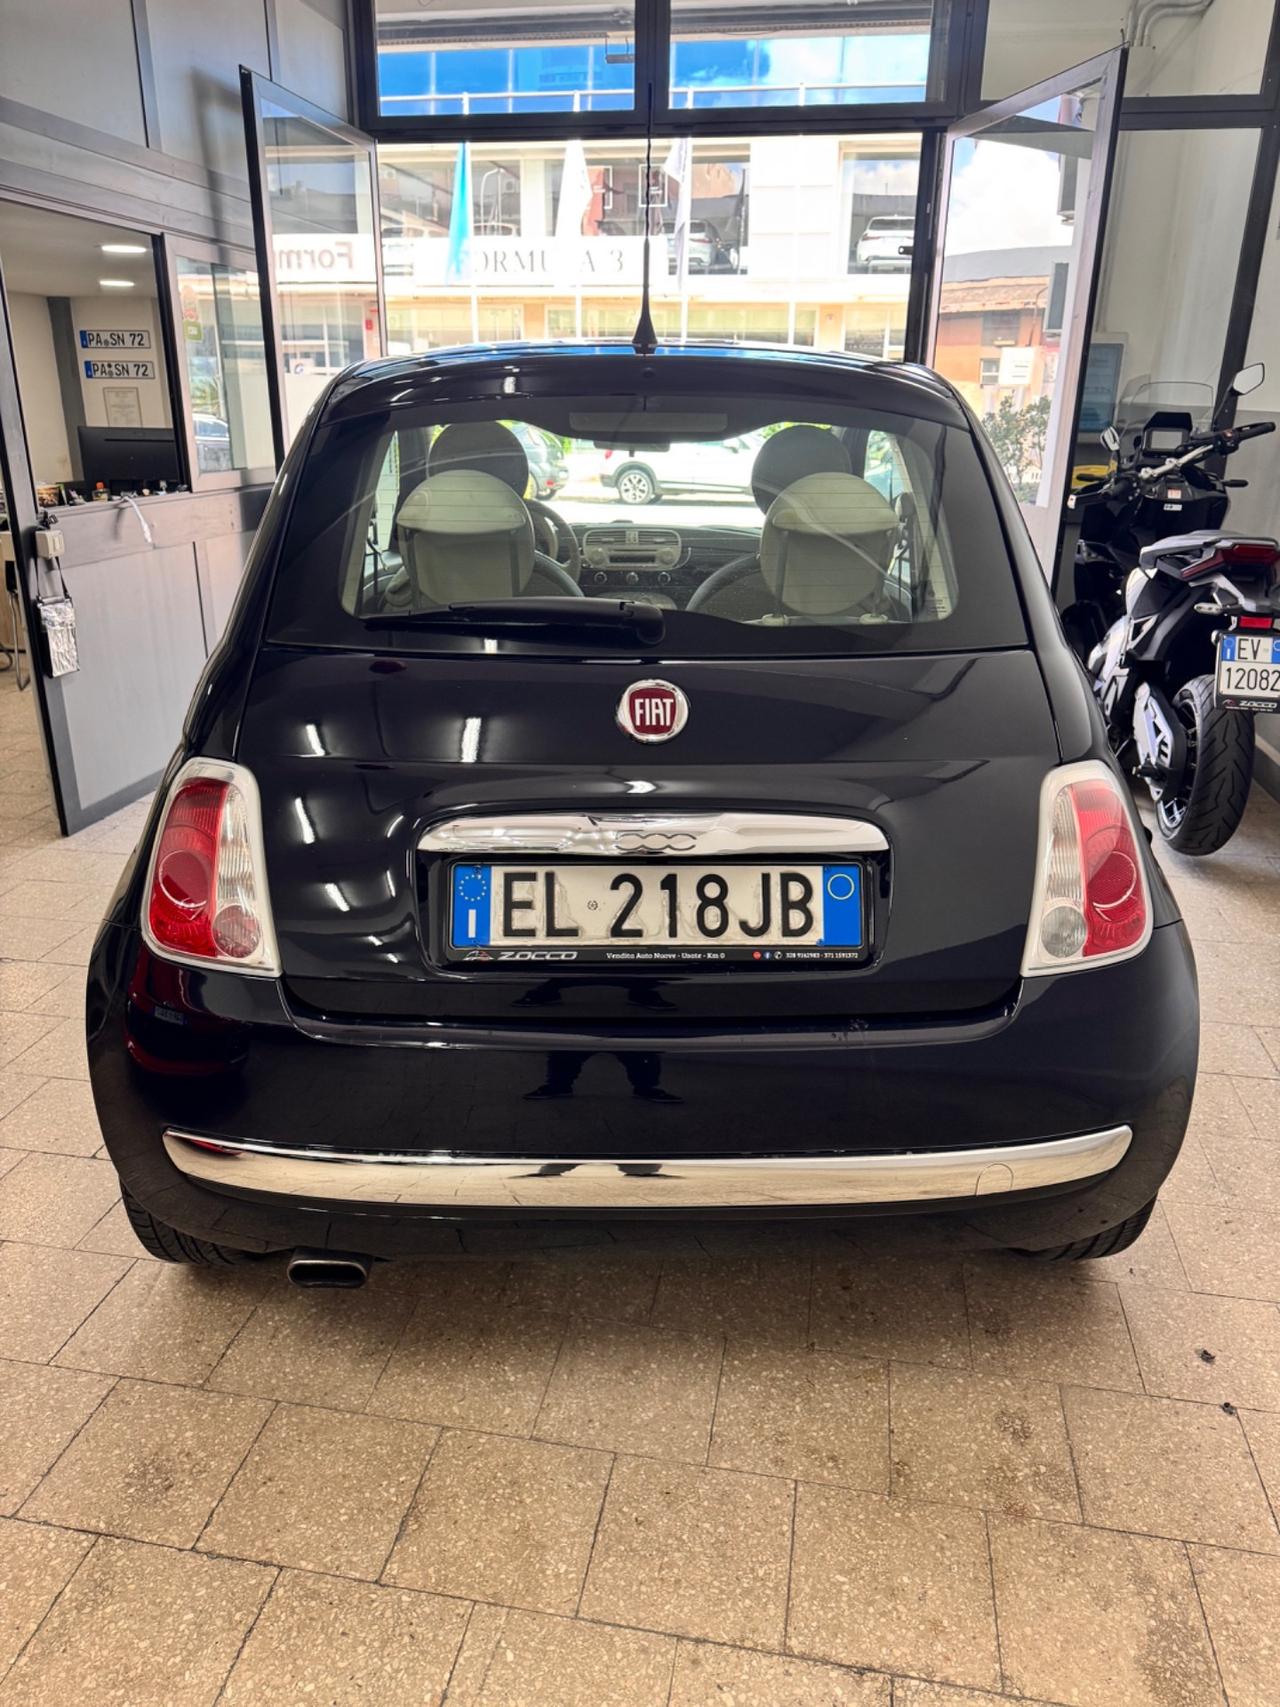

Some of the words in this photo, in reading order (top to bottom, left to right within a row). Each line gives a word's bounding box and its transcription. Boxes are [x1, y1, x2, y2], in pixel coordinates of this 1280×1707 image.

[610, 249, 623, 272] 3
[87, 333, 102, 346] PA
[110, 333, 125, 346] SN
[129, 333, 145, 346] 72
[92, 363, 107, 376] PA
[114, 363, 130, 377] SN
[133, 364, 149, 377] 72
[1237, 638, 1261, 660] EV
[1226, 667, 1280, 692] 12082
[635, 698, 674, 726] FIAT
[502, 871, 579, 938] EL
[610, 871, 814, 939] 218JB
[497, 951, 579, 961] ZOCCO
[636, 952, 653, 960] Auto
[654, 952, 676, 960] Nuove
[707, 952, 719, 960] Km
